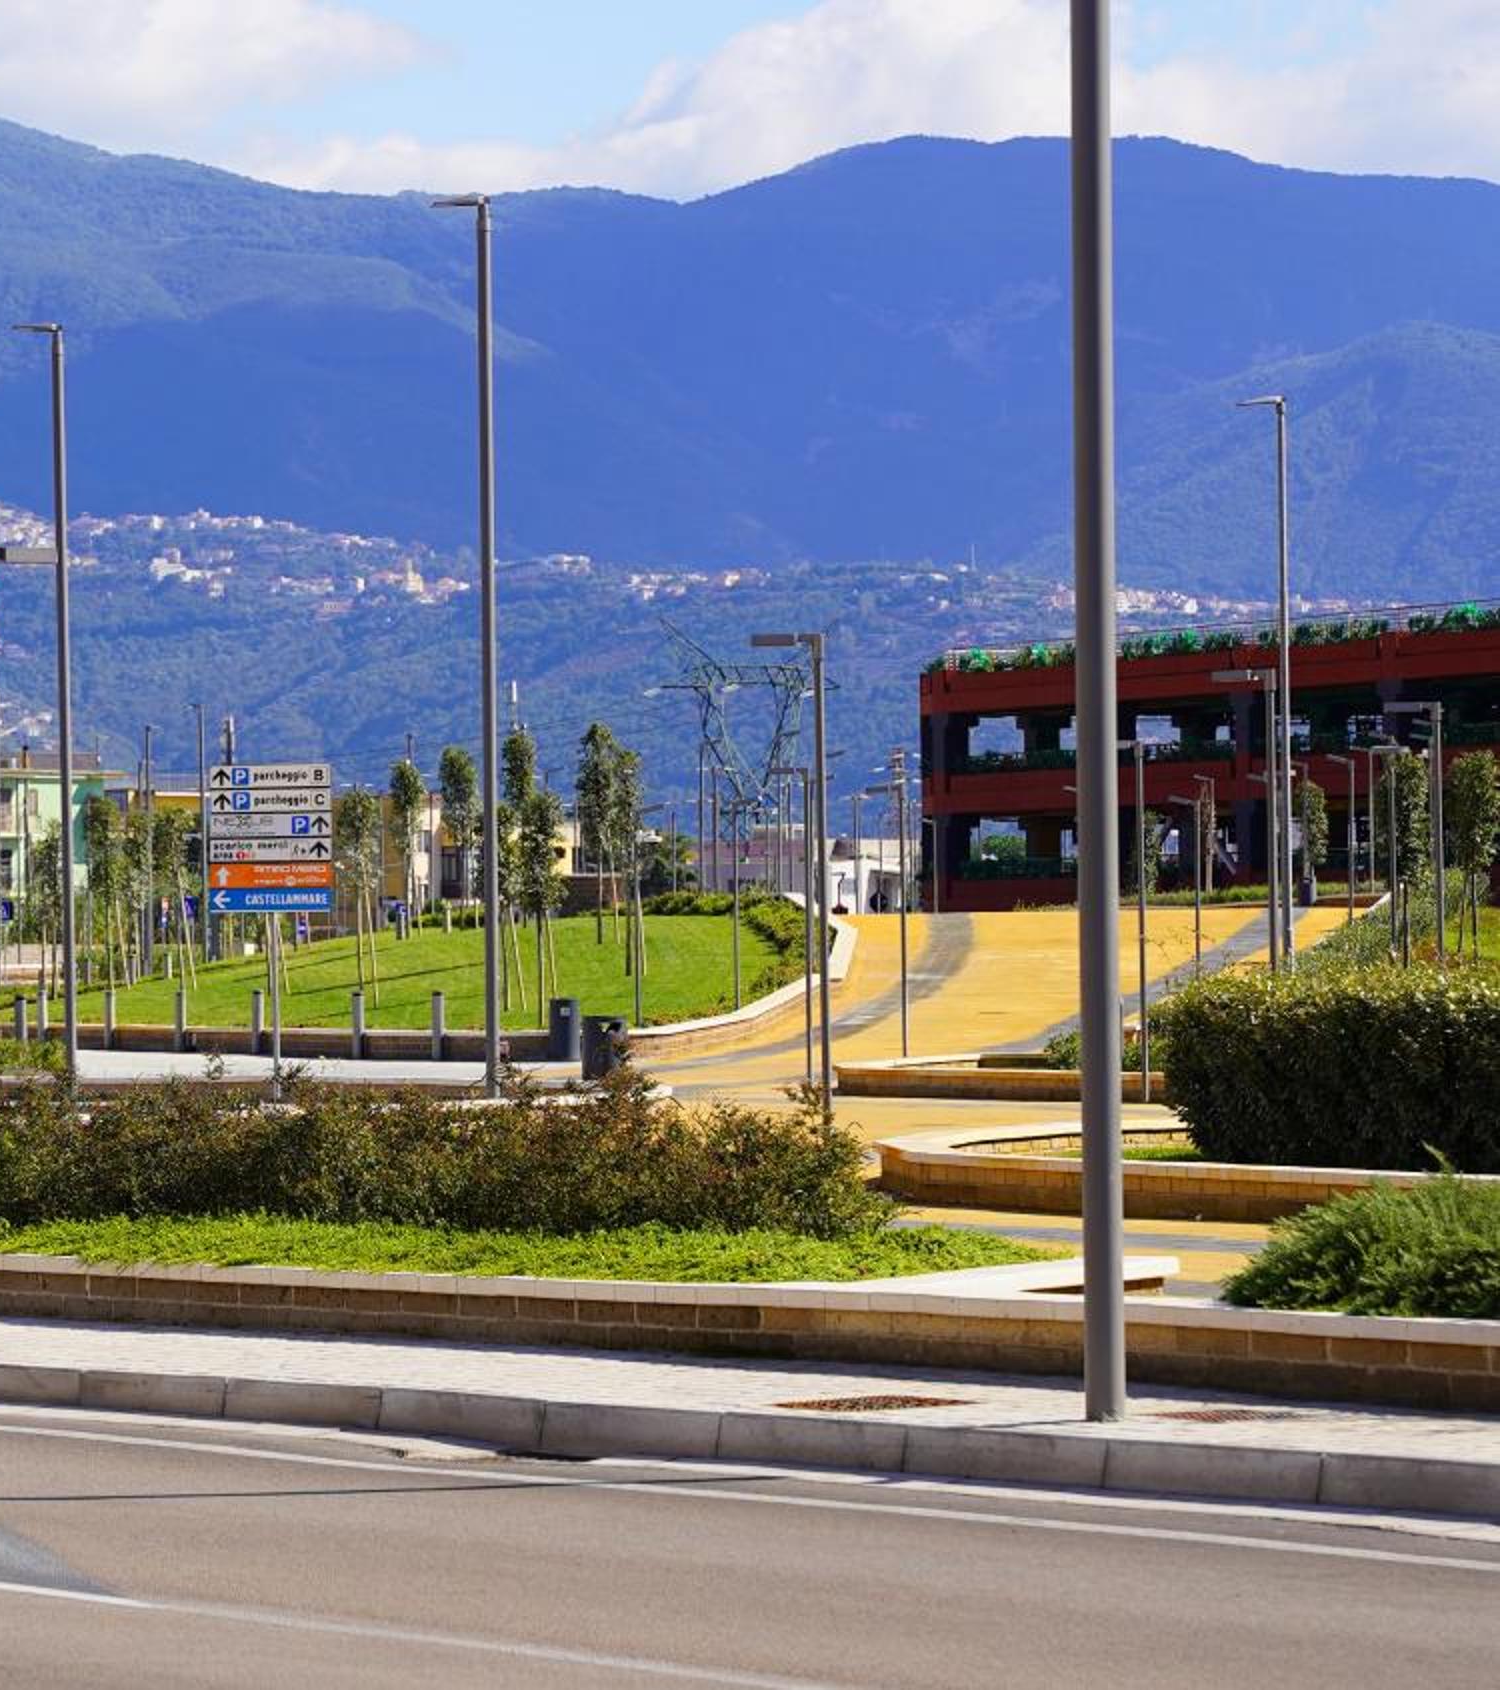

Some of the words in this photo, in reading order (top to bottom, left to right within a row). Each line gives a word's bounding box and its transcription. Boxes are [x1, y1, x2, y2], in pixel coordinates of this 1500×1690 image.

[235, 769, 247, 784] P
[254, 770, 308, 782] parcheggio
[313, 769, 324, 781] B
[236, 794, 248, 809] P
[254, 795, 308, 807] parcheggio
[315, 794, 325, 805] C
[295, 817, 307, 833] P
[245, 894, 328, 905] CASTELLAMMARE
